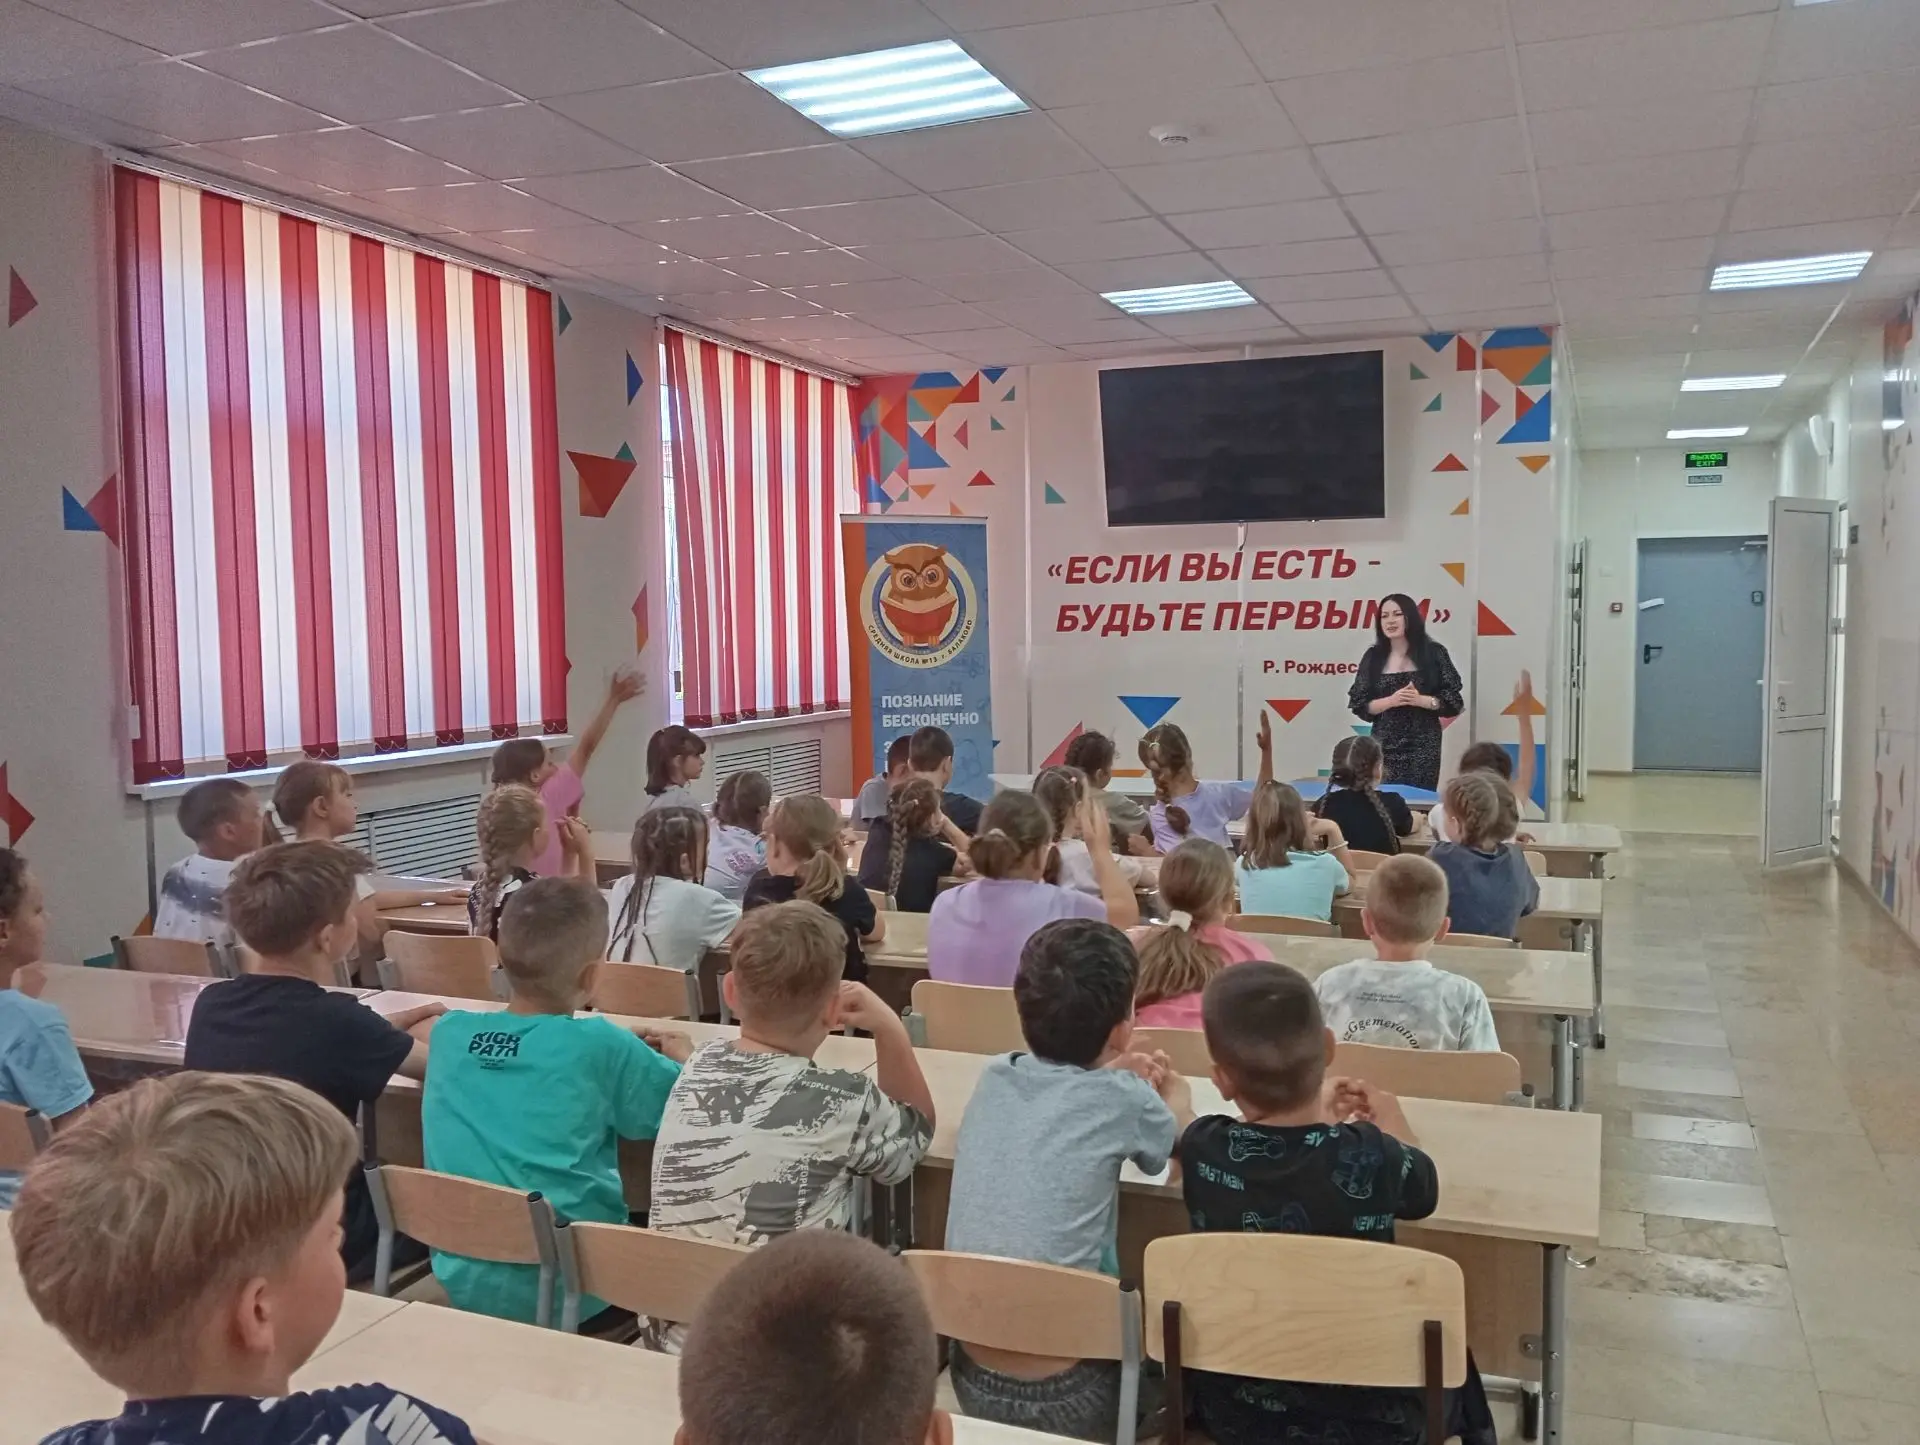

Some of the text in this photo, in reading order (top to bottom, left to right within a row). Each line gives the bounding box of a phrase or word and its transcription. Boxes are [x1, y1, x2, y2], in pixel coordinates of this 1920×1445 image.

[1047, 553, 1171, 585] «ЕСЛИ
[1179, 550, 1243, 582] ВЫ
[1251, 549, 1357, 580] ЕСТЬ
[1056, 602, 1205, 637] БУДЬТЕ
[867, 624, 893, 655] СРЕДНЯЯ
[893, 651, 919, 665] ШКОЛА
[947, 620, 973, 656] БАЛАКОВО
[1264, 660, 1358, 676] Р. Рождес
[881, 694, 962, 707] ПОЗНАНИЕ
[882, 711, 979, 728] БЕСКОНЕЧНО
[468, 1038, 520, 1057] PATH
[801, 1080, 830, 1092] PEOPLE
